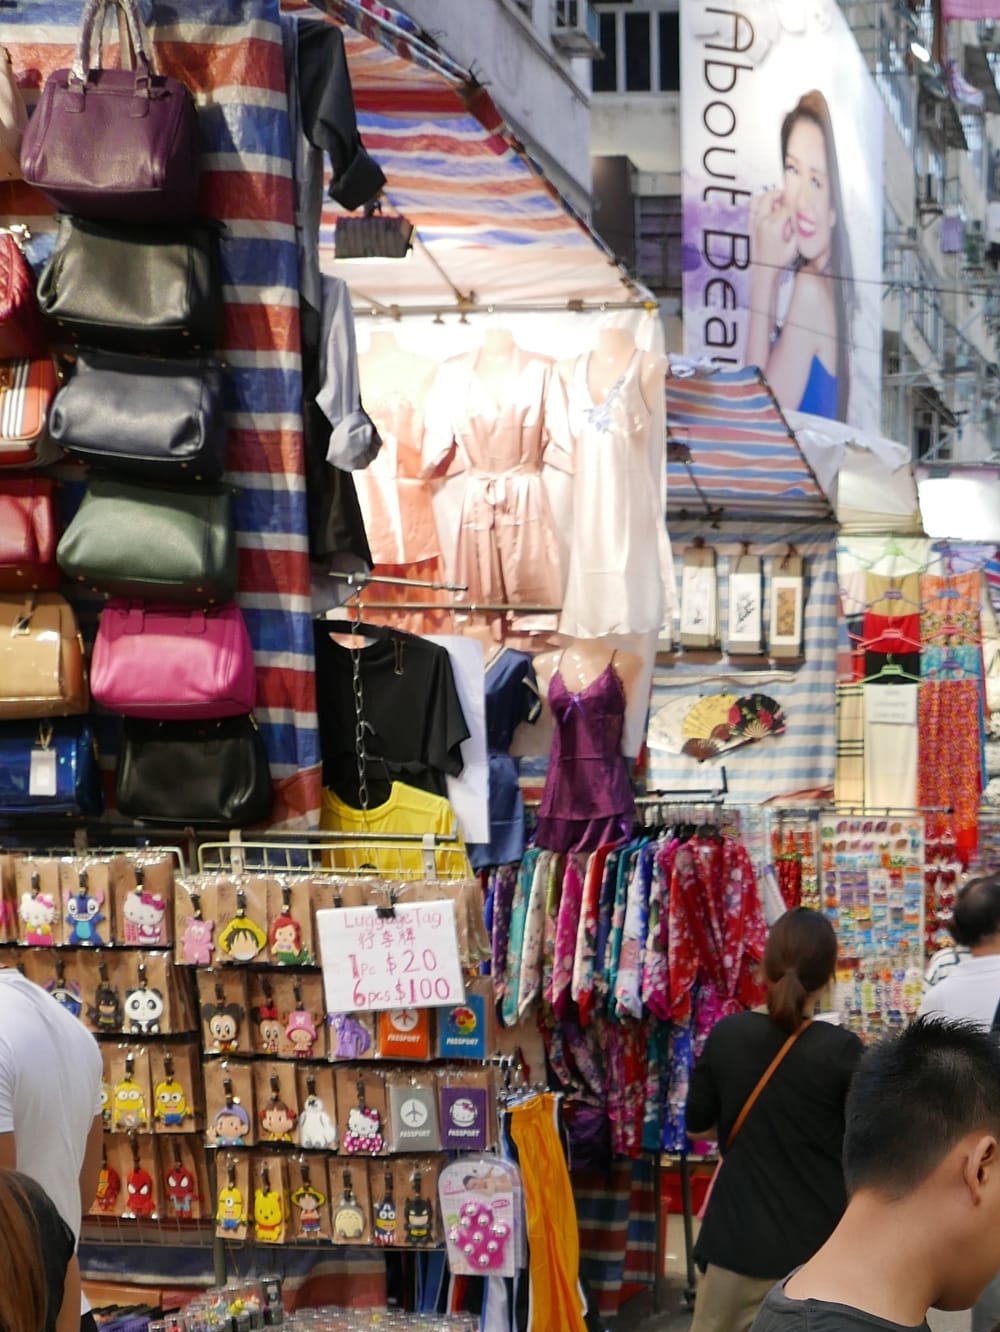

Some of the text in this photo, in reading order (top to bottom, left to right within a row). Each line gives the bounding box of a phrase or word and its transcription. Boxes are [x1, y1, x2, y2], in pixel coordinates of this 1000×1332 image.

[703, 7, 754, 206] About
[386, 949, 437, 976] $20
[394, 977, 450, 1005] $100
